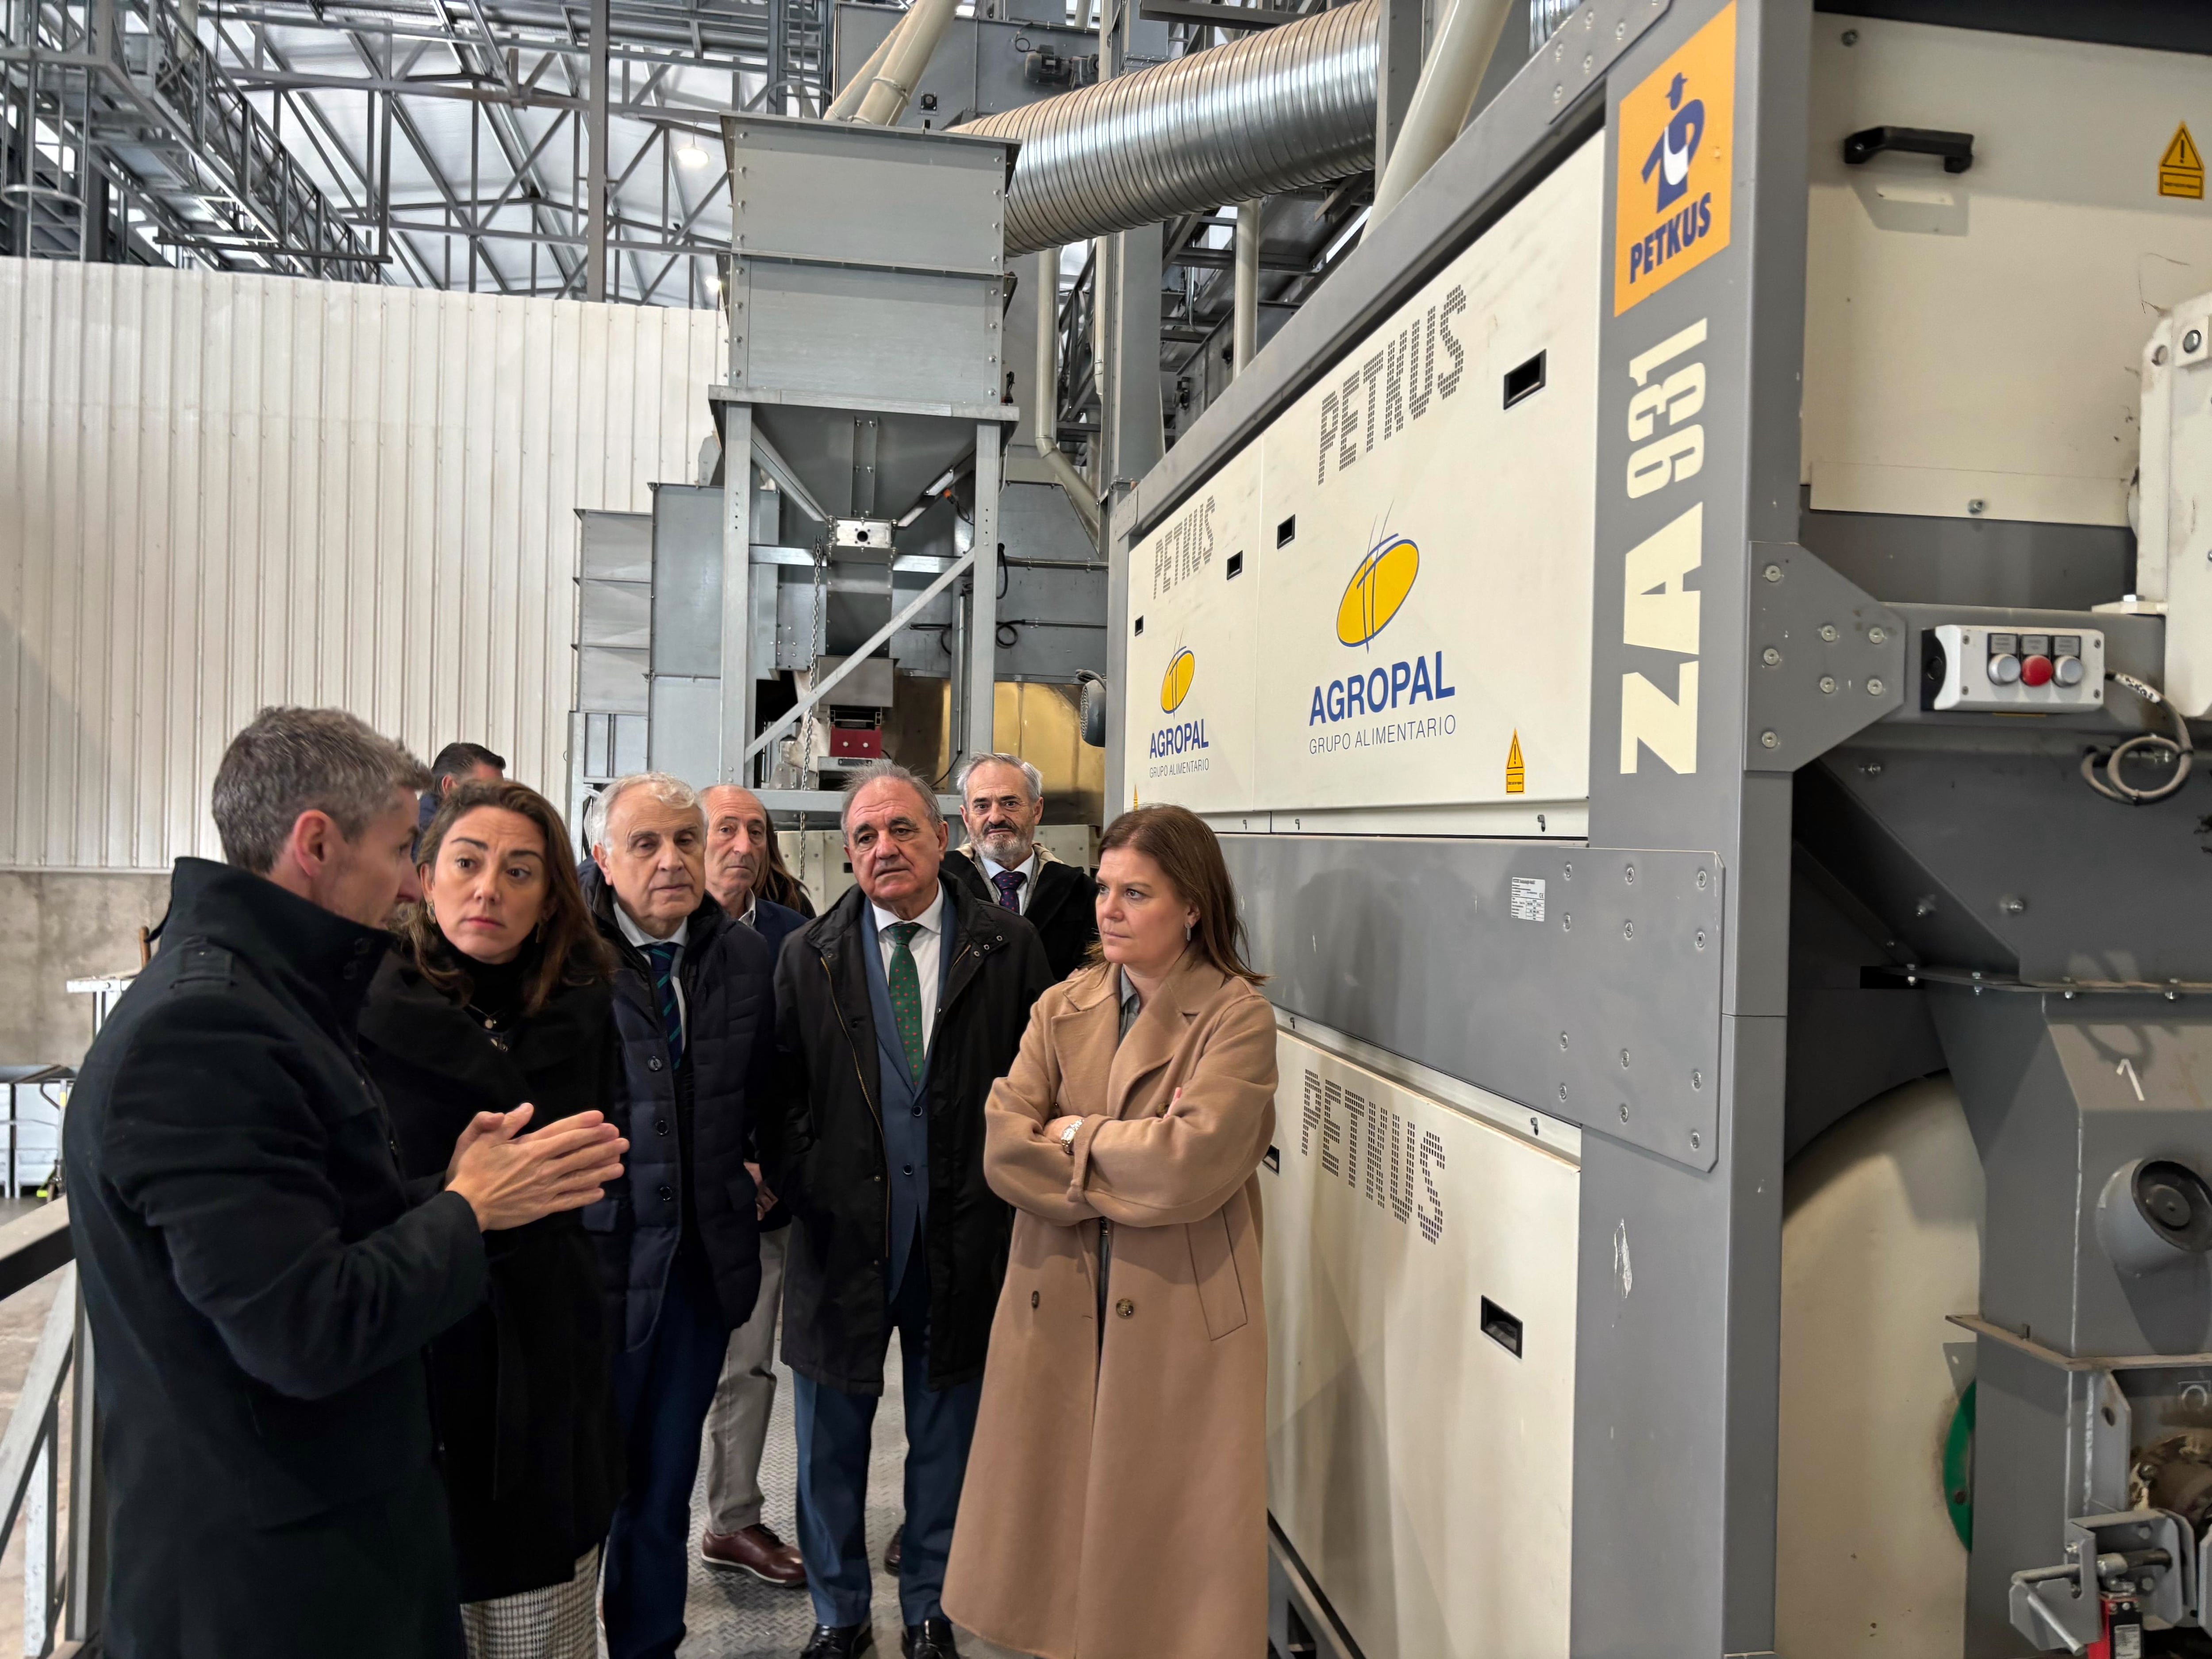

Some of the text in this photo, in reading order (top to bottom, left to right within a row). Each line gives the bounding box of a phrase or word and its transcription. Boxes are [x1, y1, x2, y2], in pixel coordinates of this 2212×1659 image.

[1630, 192, 1711, 284] PETKUS
[1318, 284, 1466, 486] PETKUS
[1153, 495, 1215, 599] PETKUS
[1621, 317, 1707, 774] ZA 931
[1310, 651, 1455, 726] AGROPAL
[1310, 714, 1455, 754] GRUPO ALIMENTARIO
[1150, 718, 1209, 759] AGROPAL
[1150, 758, 1209, 778] GRUPO ALIMENTARIO
[1302, 1068, 1445, 1244] PETKUS
